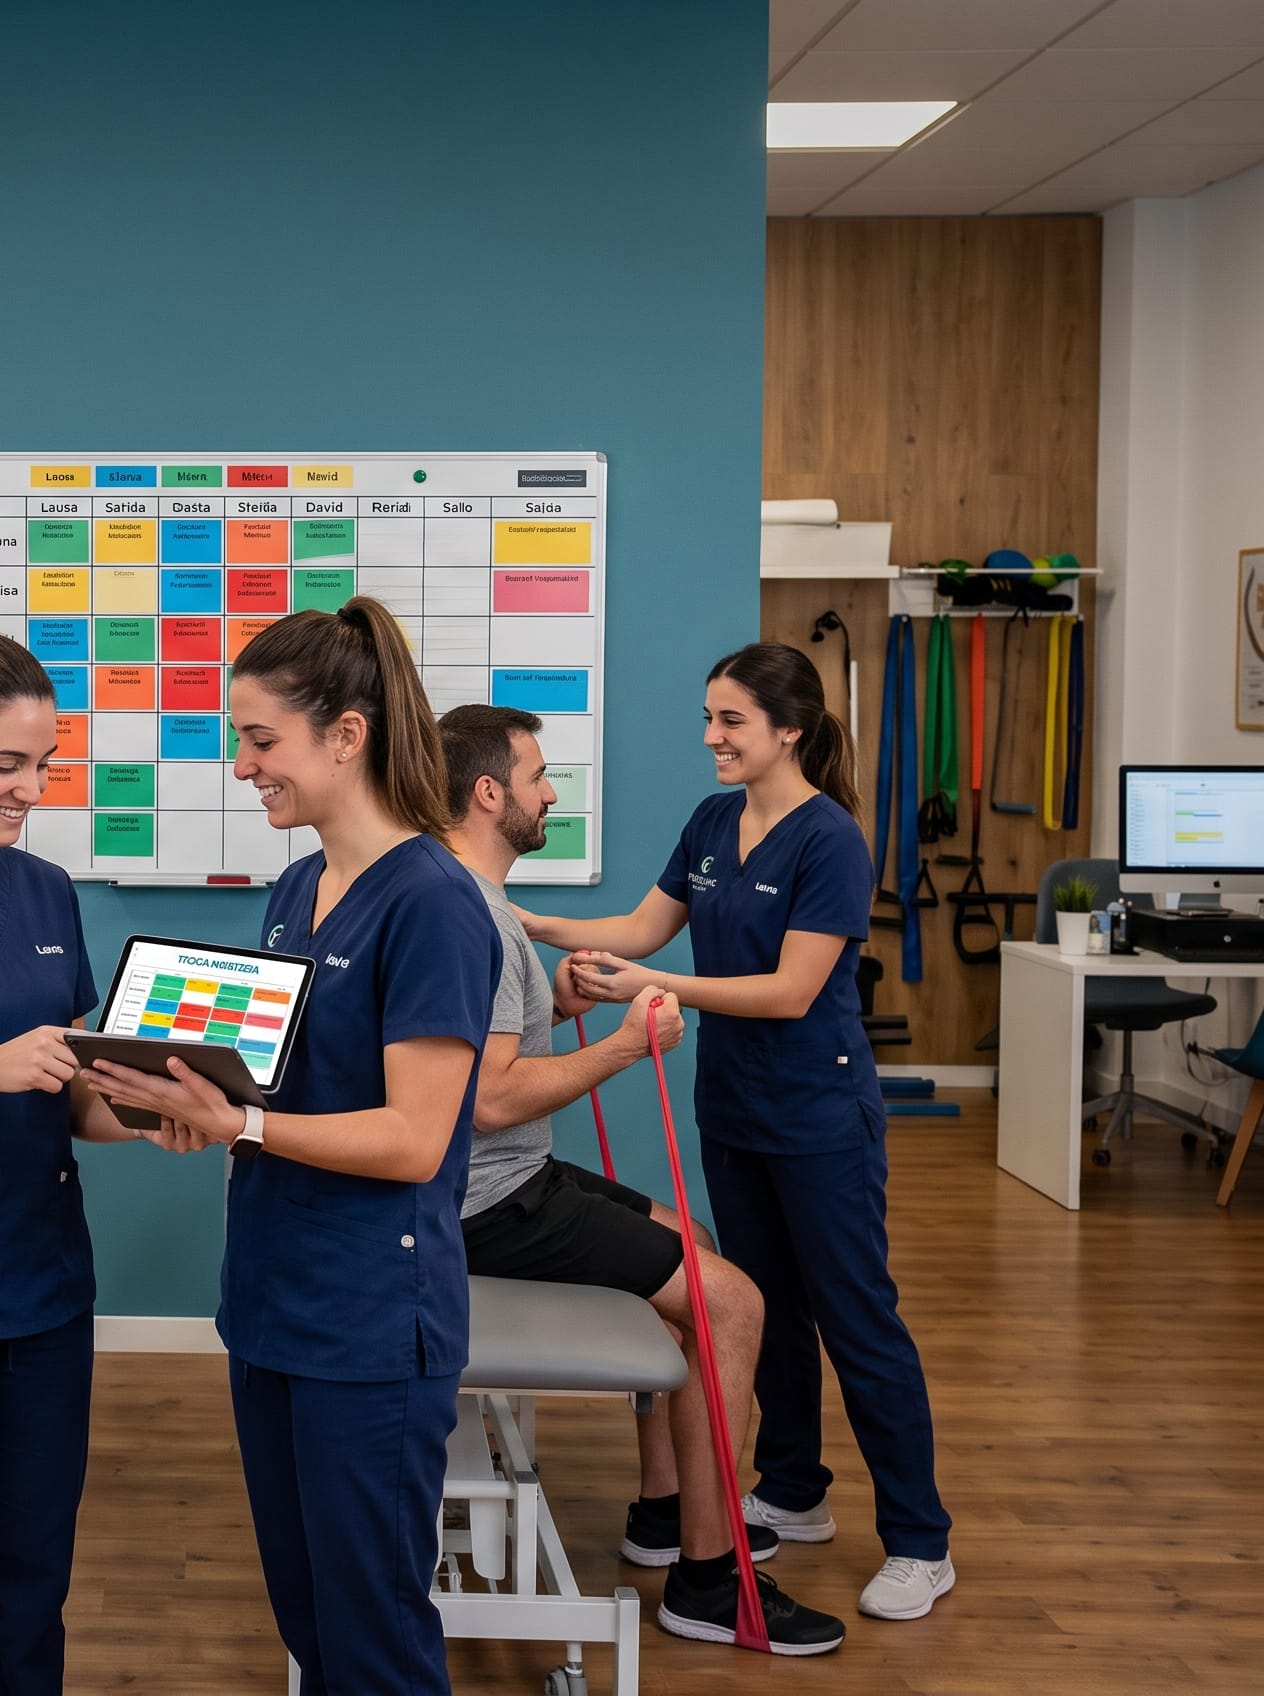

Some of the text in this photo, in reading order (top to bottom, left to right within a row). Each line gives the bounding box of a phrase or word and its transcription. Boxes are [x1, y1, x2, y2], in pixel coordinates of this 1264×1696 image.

[41, 502, 78, 513] Lausa
[305, 501, 344, 513] David
[442, 501, 474, 513] Sallo
